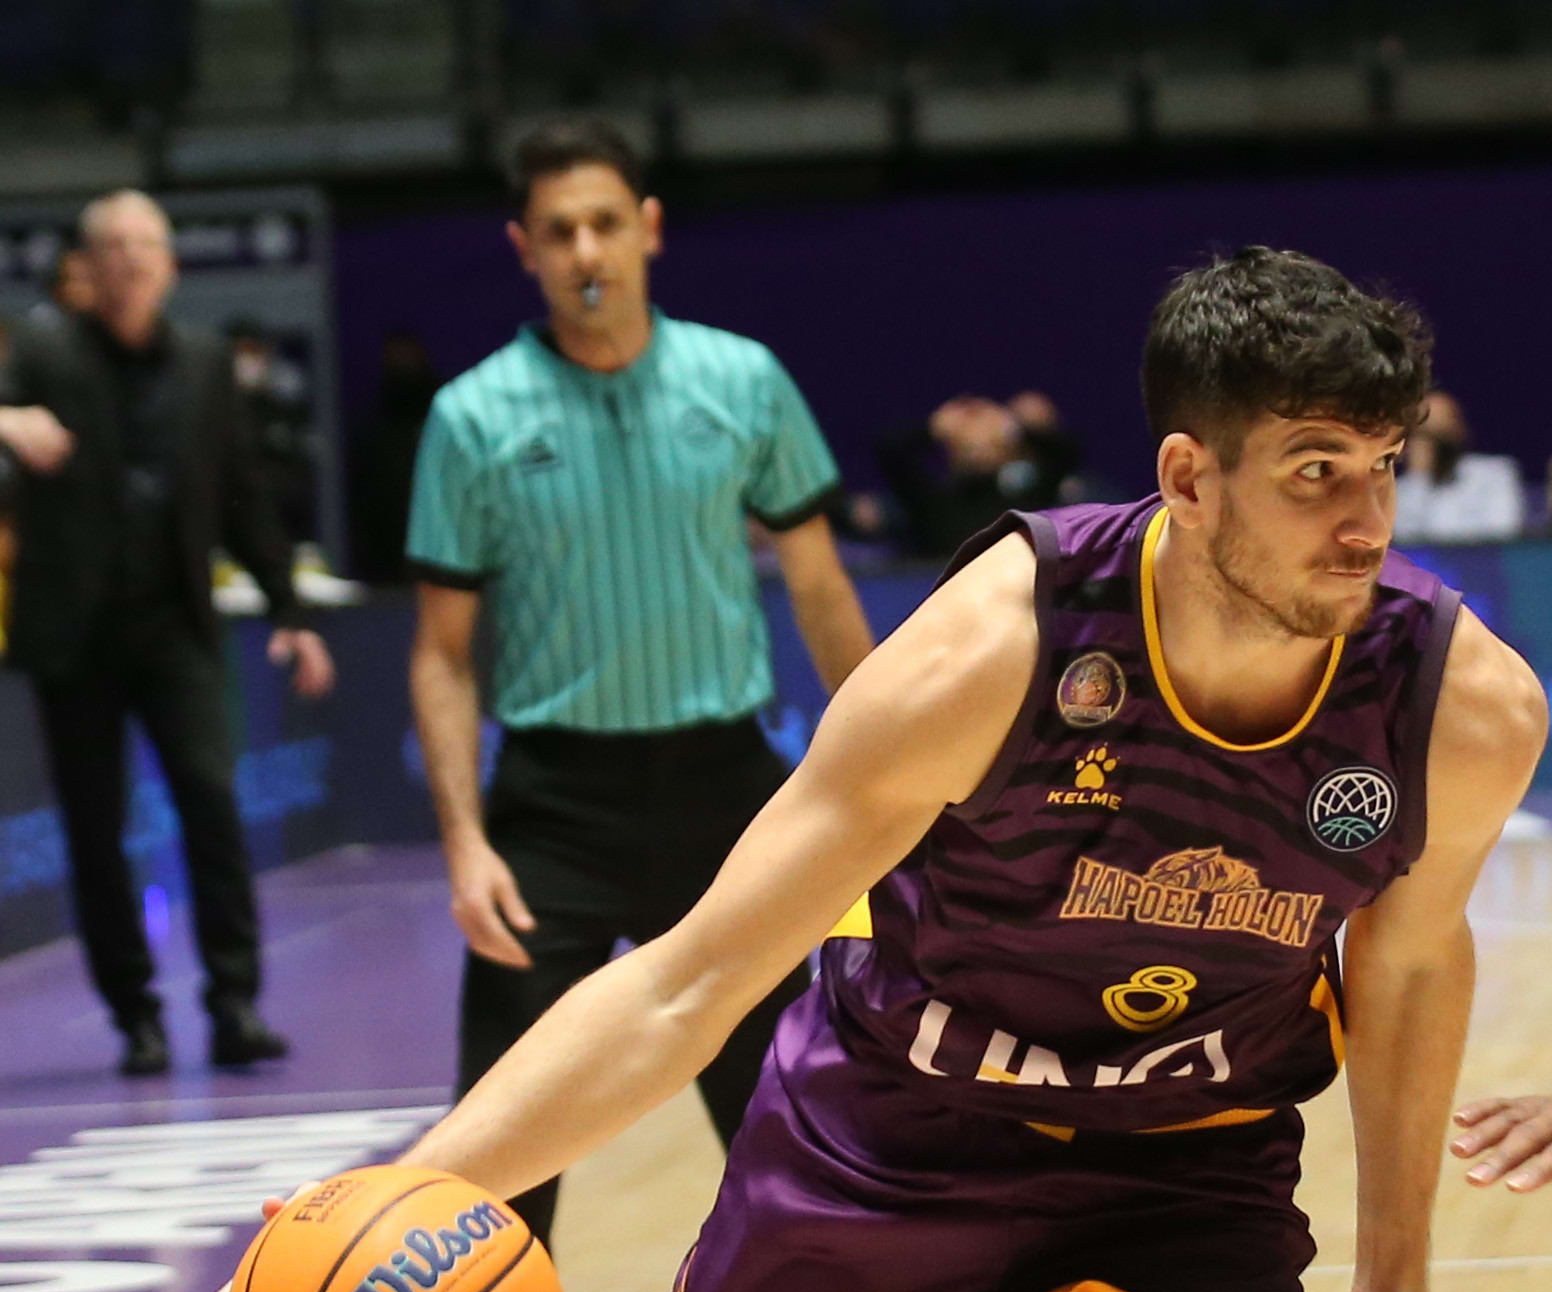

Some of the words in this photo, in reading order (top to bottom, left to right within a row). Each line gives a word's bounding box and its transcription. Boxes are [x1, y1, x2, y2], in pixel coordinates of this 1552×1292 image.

[1047, 790, 1123, 811] KELME
[1059, 856, 1203, 929] HAPOEL
[1203, 887, 1324, 947] HOLON
[1102, 965, 1197, 1032] 8
